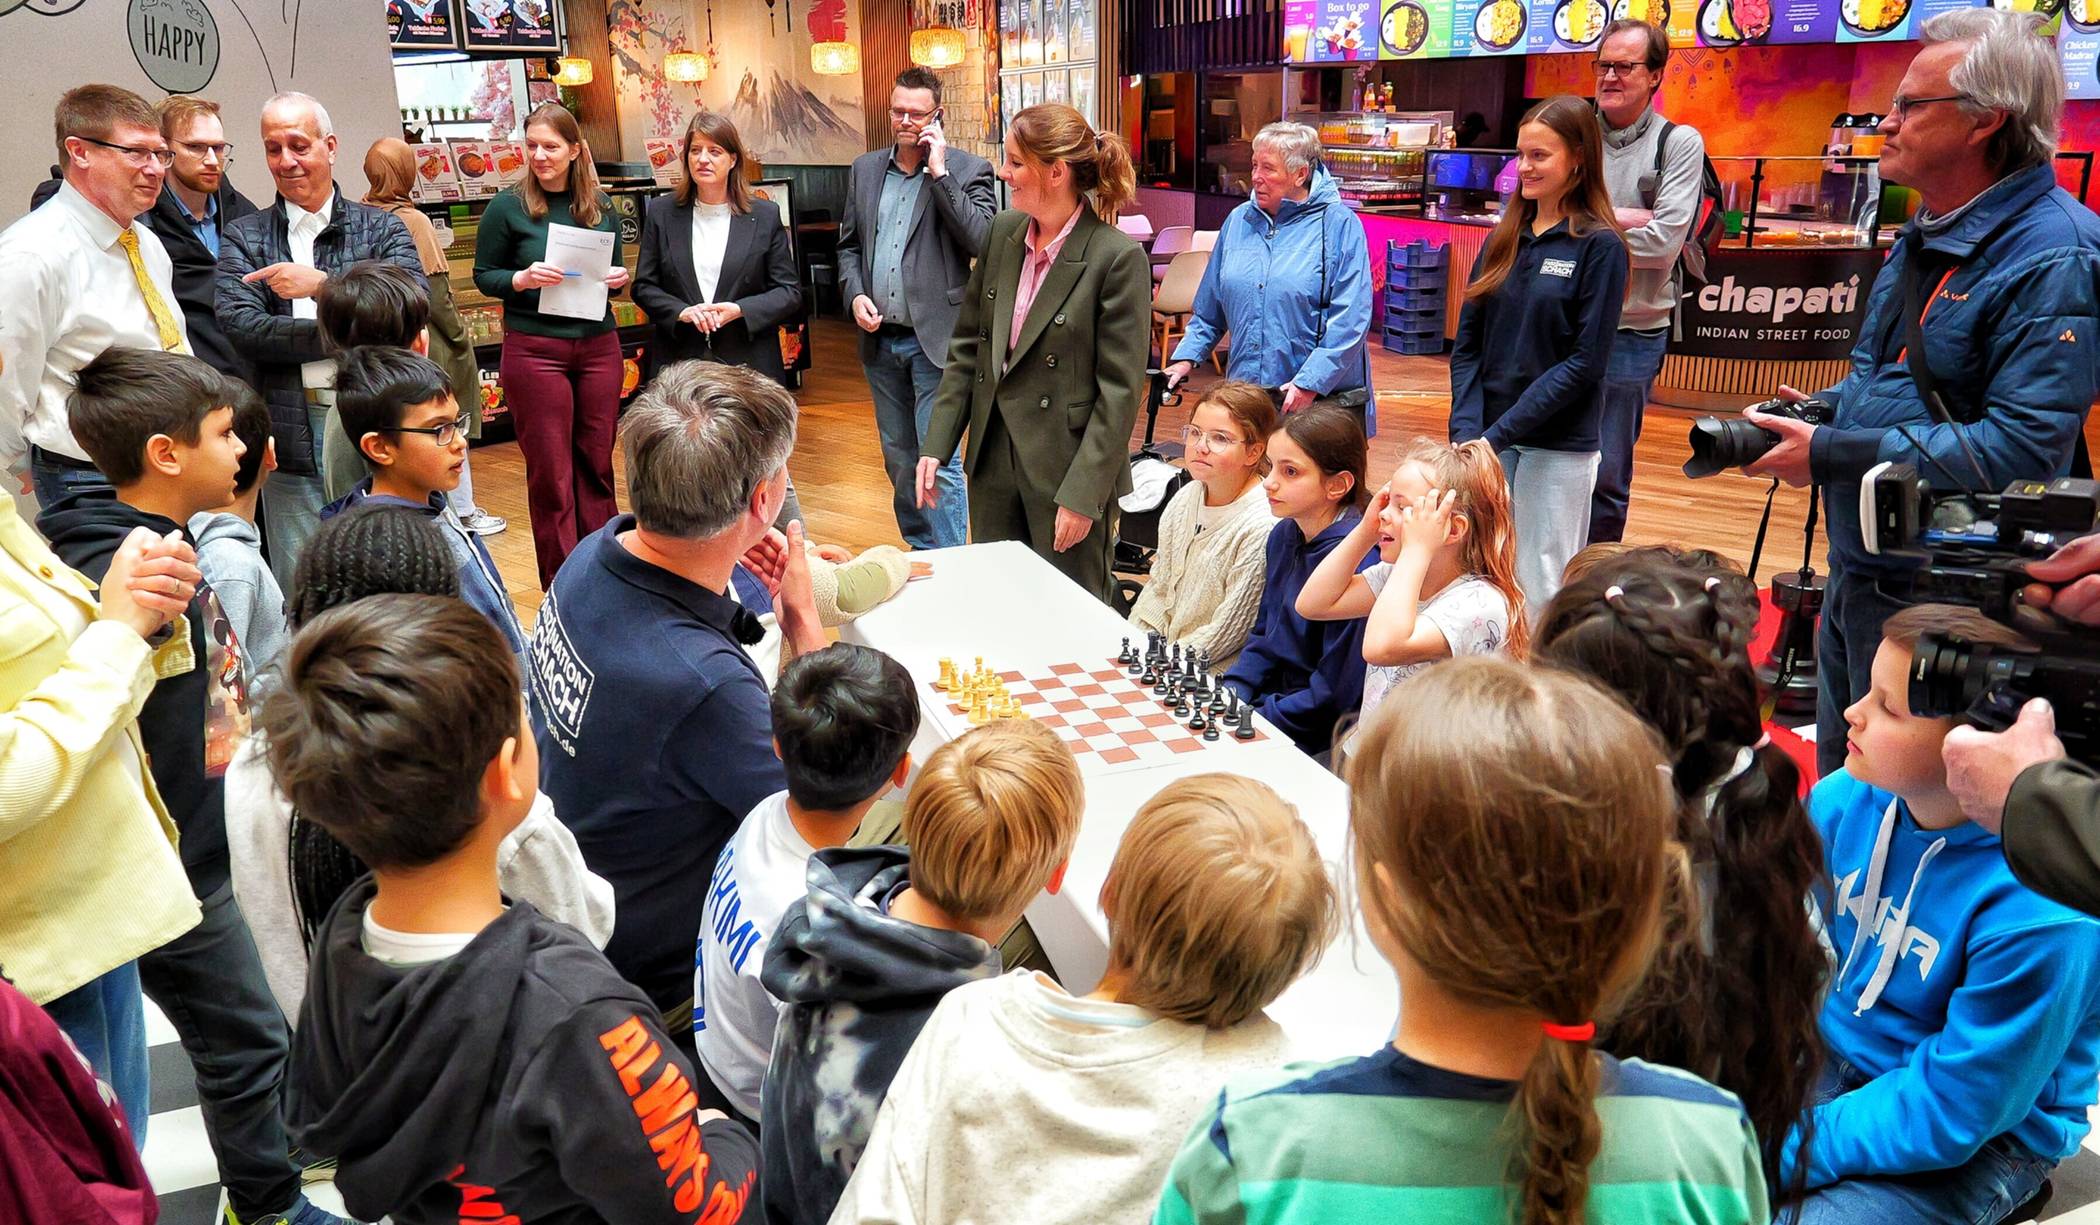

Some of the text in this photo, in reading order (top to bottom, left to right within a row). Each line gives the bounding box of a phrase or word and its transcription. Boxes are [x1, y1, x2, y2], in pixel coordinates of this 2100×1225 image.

[1327, 3, 1369, 13] Box to go
[144, 14, 205, 66] HAPPY
[2065, 40, 2098, 50] Chicken
[2063, 52, 2094, 60] Madras
[1698, 273, 1860, 323] chapati
[1696, 326, 1850, 341] INDIAN STREET FOOD
[598, 1014, 709, 1214] ALWAYS
